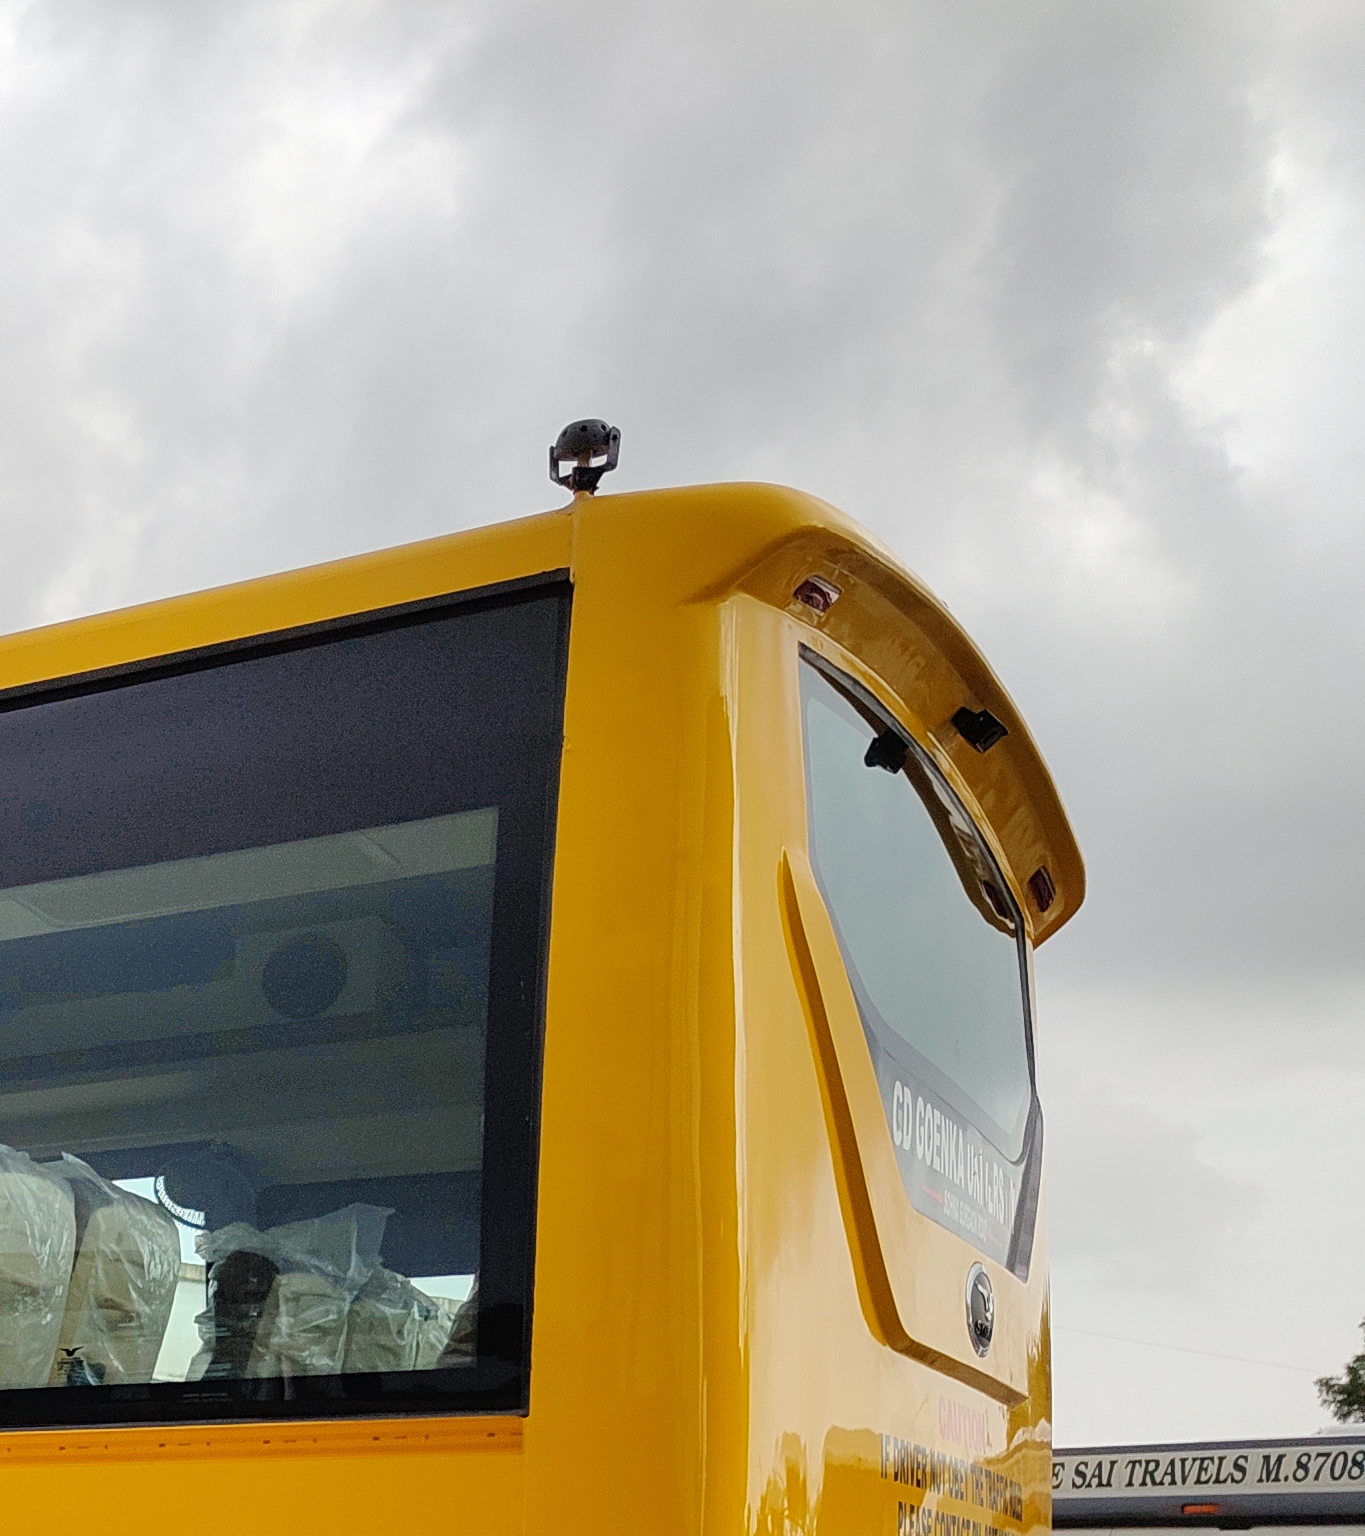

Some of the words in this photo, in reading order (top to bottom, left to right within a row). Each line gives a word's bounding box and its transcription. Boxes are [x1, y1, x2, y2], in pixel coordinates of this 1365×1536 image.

[916, 1096, 964, 1189] GOENKA
[893, 1436, 928, 1490] DRIVER
[1072, 1459, 1118, 1490] SAI
[1125, 1453, 1249, 1488] TRAVELS
